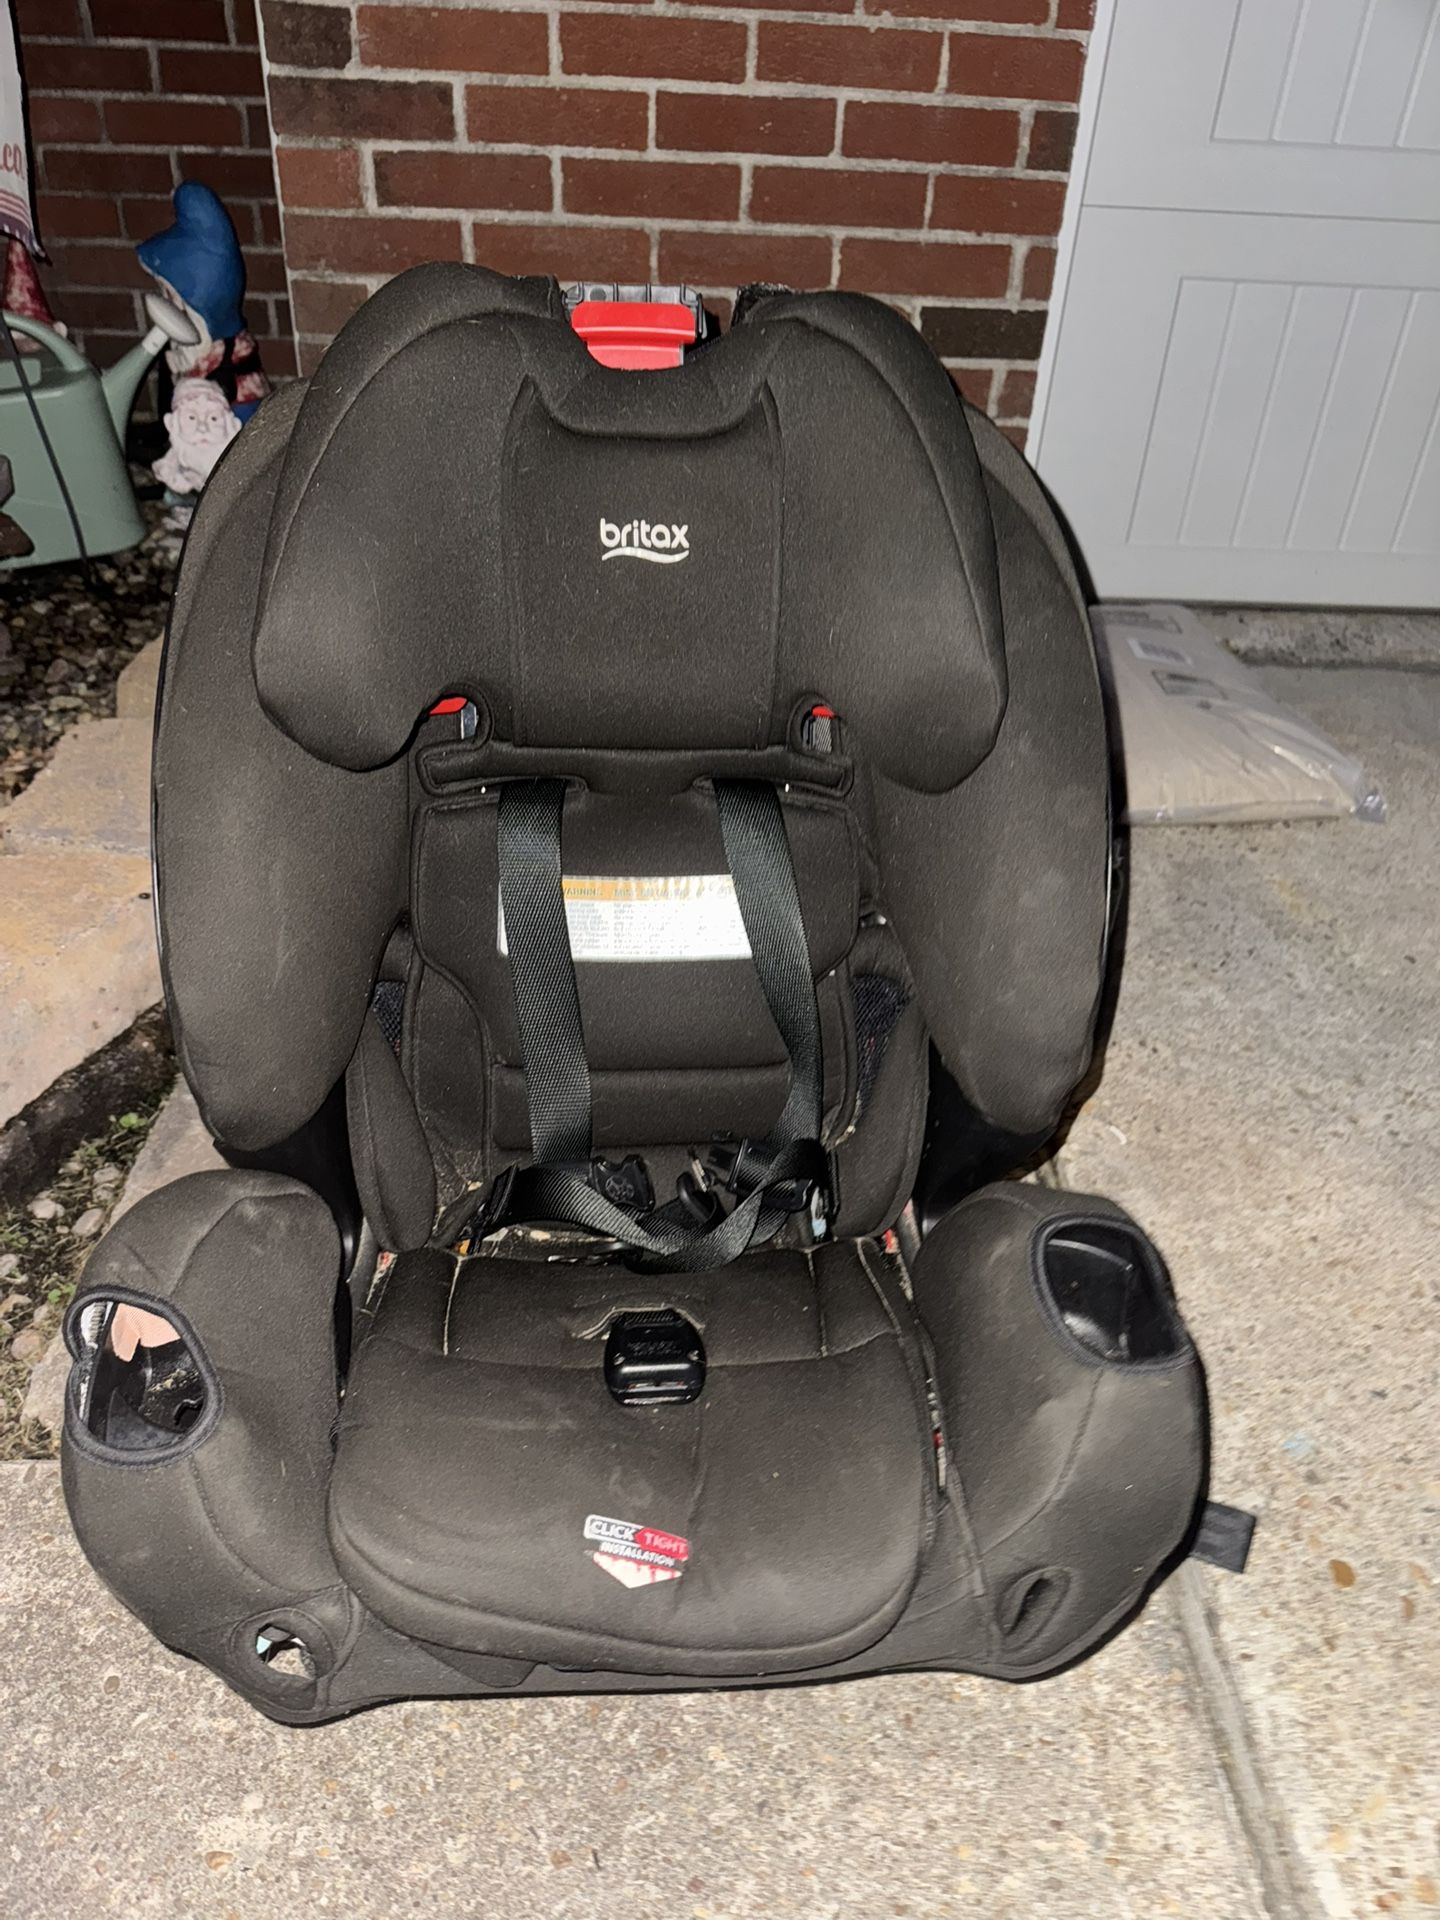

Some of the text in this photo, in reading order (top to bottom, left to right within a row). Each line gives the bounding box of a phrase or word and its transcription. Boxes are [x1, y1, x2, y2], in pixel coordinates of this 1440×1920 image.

[600, 517, 690, 549] britax
[589, 1520, 687, 1554] CLICK TIGHT
[600, 1541, 676, 1567] INSTALLATION
